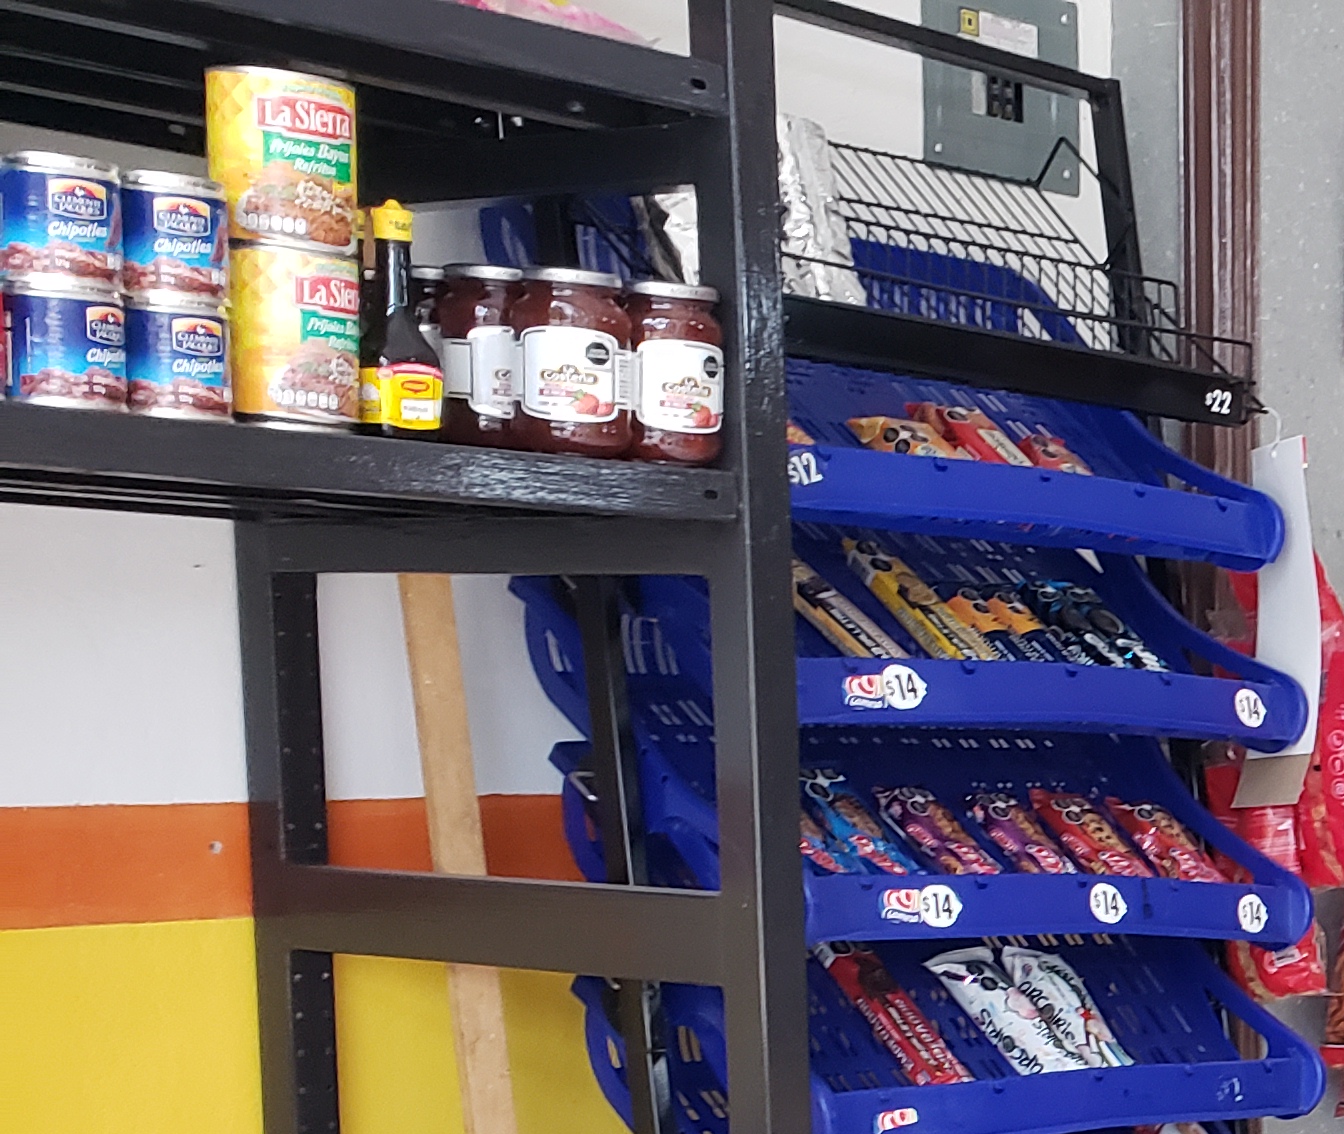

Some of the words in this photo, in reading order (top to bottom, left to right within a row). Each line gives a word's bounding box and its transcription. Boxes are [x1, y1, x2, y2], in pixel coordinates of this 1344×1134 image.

[264, 100, 292, 127] La
[299, 98, 350, 137] Sierra
[48, 221, 108, 240] Chipotles
[154, 238, 212, 256] Chipotles
[303, 278, 328, 306] La
[331, 281, 359, 316] Sier
[172, 359, 224, 377] Chipotles
[1205, 390, 1233, 415] $22
[885, 673, 919, 700] $14
[924, 893, 956, 921] $14
[1094, 891, 1121, 919] $14
